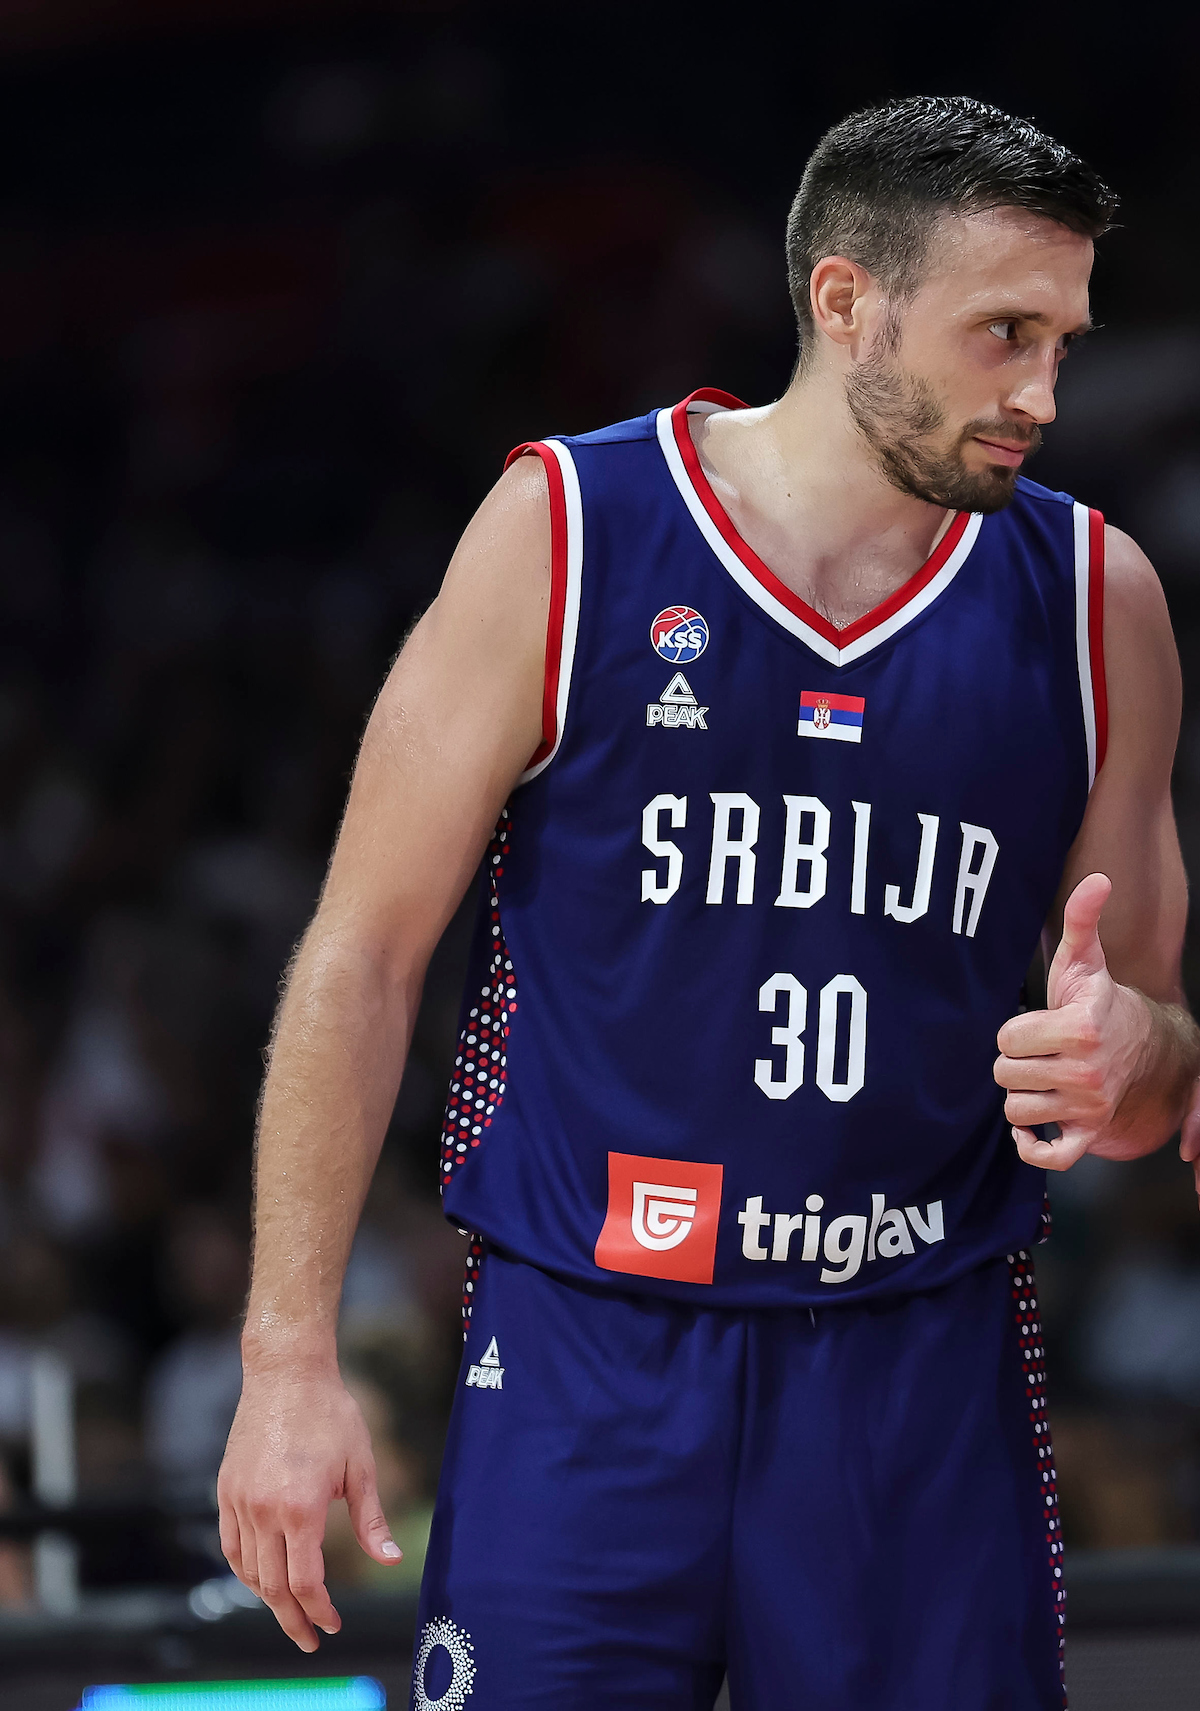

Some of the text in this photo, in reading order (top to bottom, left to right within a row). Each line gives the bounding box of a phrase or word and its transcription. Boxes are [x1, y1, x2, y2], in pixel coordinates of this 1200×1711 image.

[659, 631, 702, 649] KSS
[646, 704, 709, 730] PEAK
[641, 792, 1000, 938] SRBIJA
[754, 972, 868, 1103] 30
[738, 1193, 945, 1283] triglav
[465, 1365, 506, 1390] PEAK
